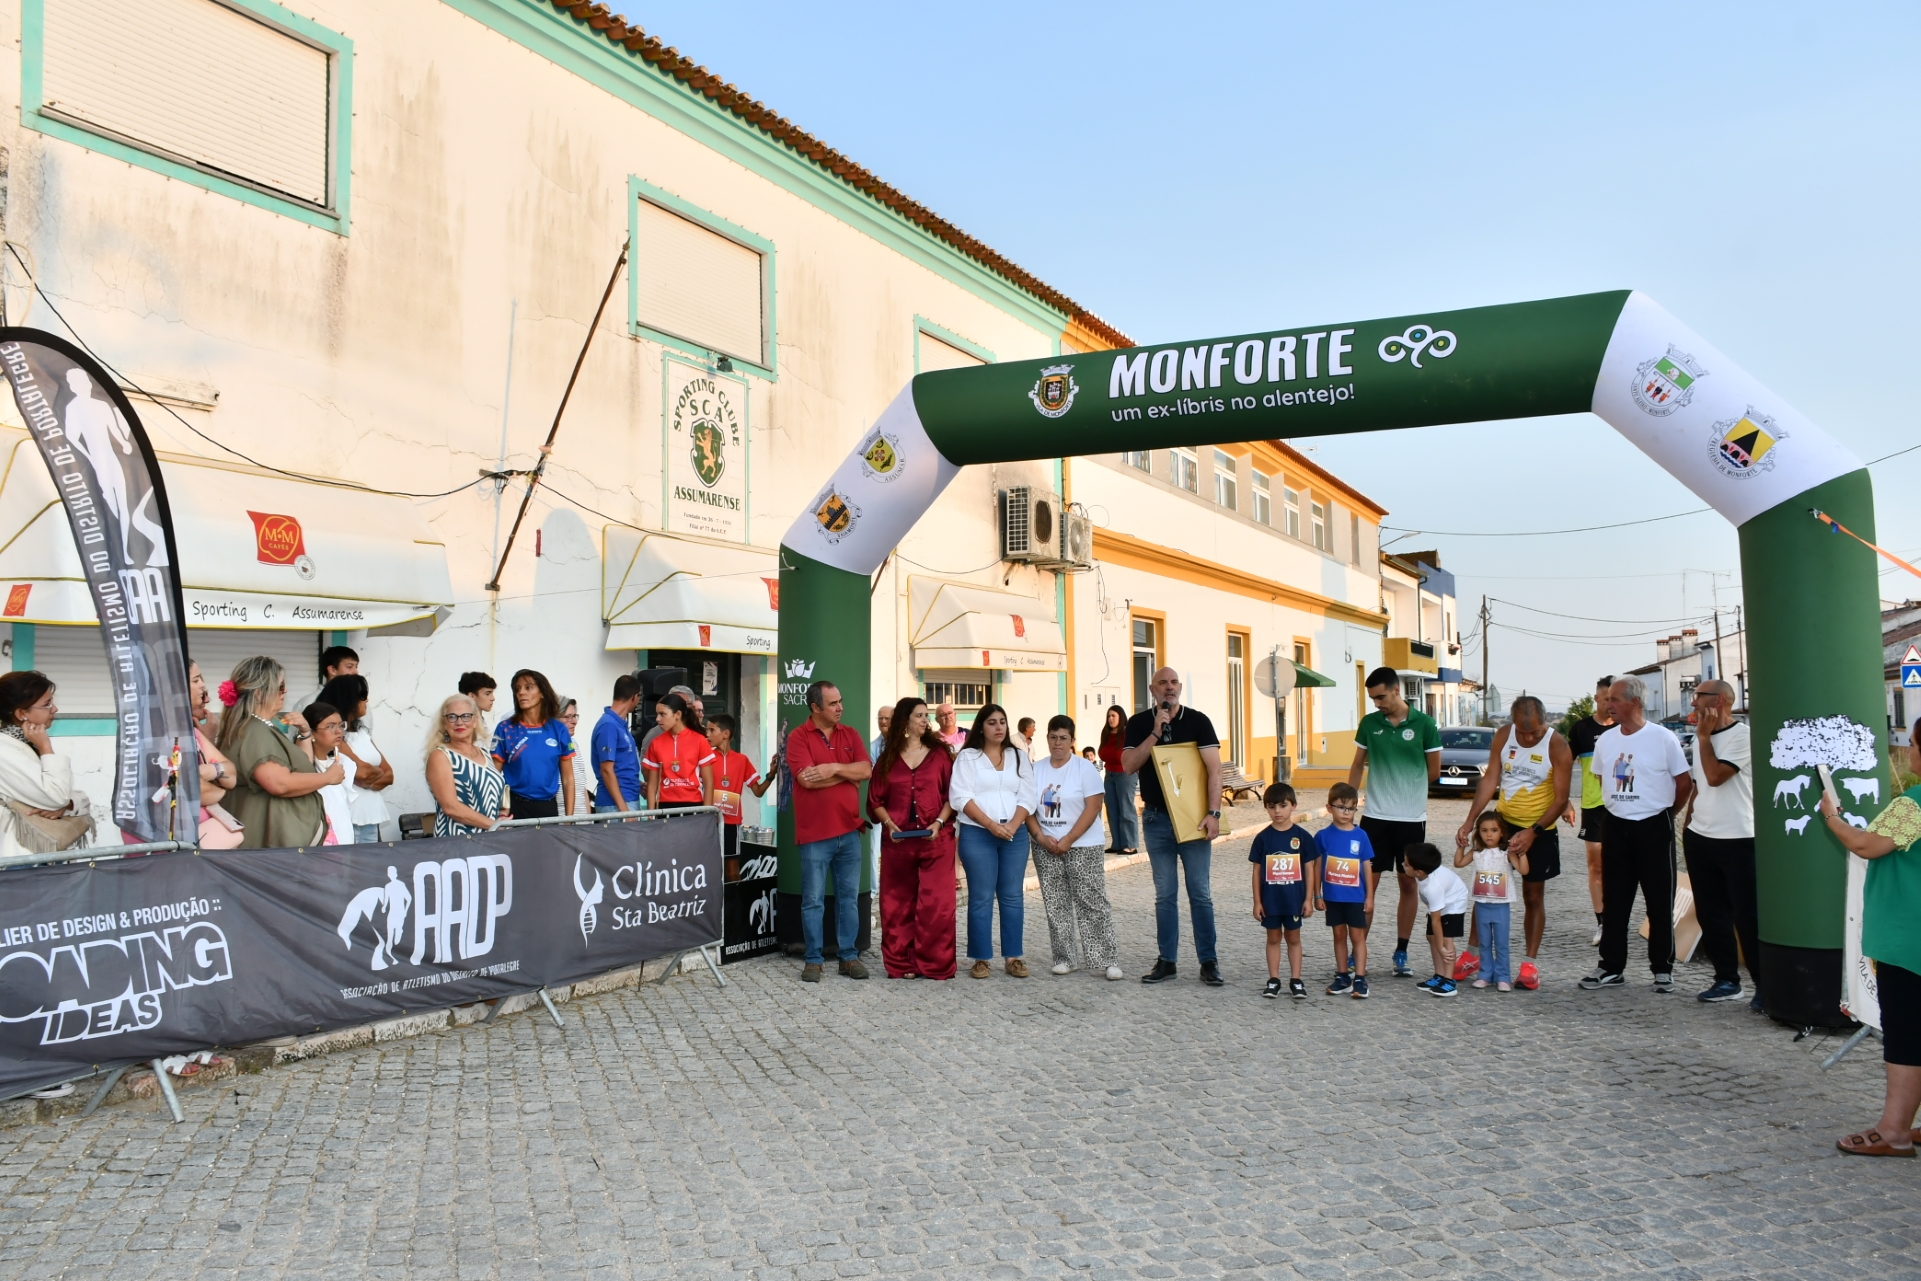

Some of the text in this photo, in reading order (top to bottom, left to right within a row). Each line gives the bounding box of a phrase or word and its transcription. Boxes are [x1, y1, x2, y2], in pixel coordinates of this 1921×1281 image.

[1108, 328, 1355, 399] MONFORTE
[673, 379, 740, 447] SPORTING CLUBE
[1111, 383, 1355, 422] um ex-líbris no alentejo!
[673, 485, 741, 512] ASSUMARENSE
[192, 600, 364, 622] Sporting C. Assumarense
[746, 635, 771, 651] Sporting
[722, 793, 728, 802] 5
[612, 858, 707, 900] Clínica
[1272, 858, 1294, 870] 287
[1336, 860, 1350, 872] 74
[1479, 874, 1500, 885] 545
[36, 921, 60, 941] DE
[63, 913, 116, 938] DESIGN
[119, 911, 131, 928] &
[133, 897, 210, 926] PRODUÇÃO
[410, 853, 513, 965] AADP
[612, 895, 706, 930] Sta Beatriz
[391, 981, 400, 992] DE
[403, 973, 441, 990] ATLETISMO
[1859, 956, 1877, 996] VILA DE
[40, 993, 163, 1045] IDEAS
